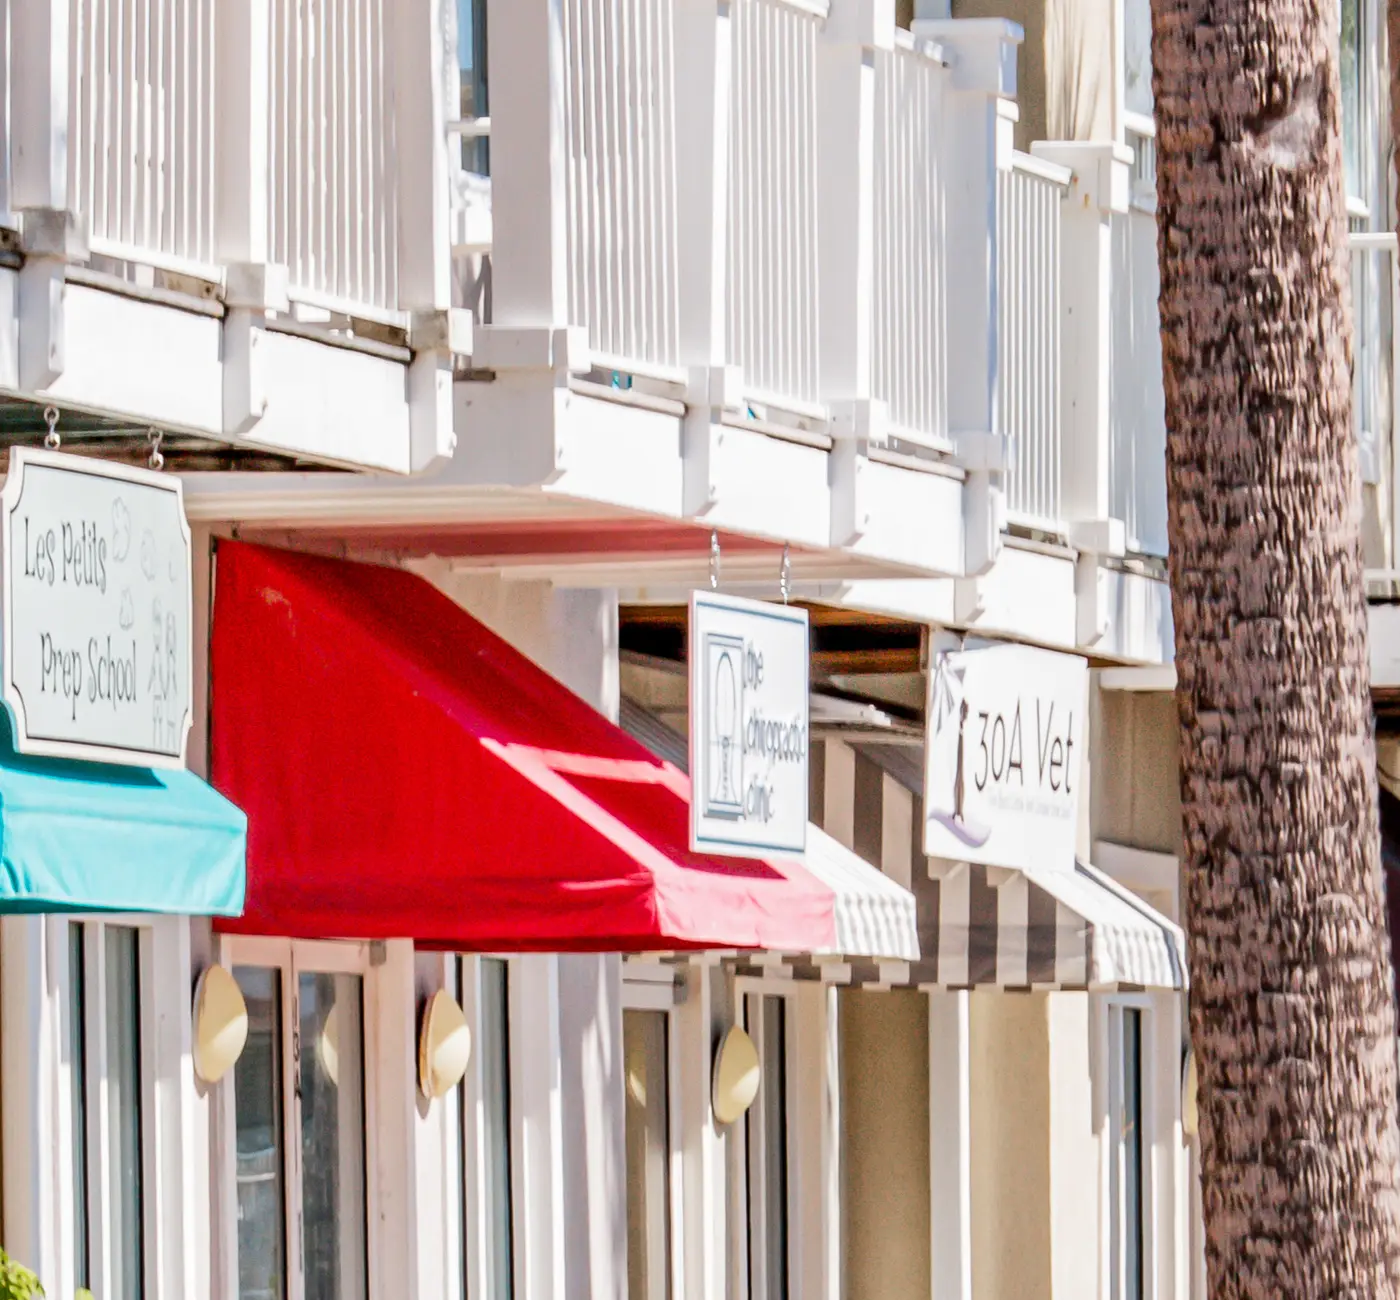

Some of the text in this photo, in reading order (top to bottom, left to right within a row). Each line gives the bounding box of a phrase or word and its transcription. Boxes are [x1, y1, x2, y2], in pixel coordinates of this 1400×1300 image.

[24, 516, 107, 595] Les Petits
[39, 631, 138, 721] Prep School
[746, 641, 764, 690] the
[974, 695, 1073, 794] 30A Vet
